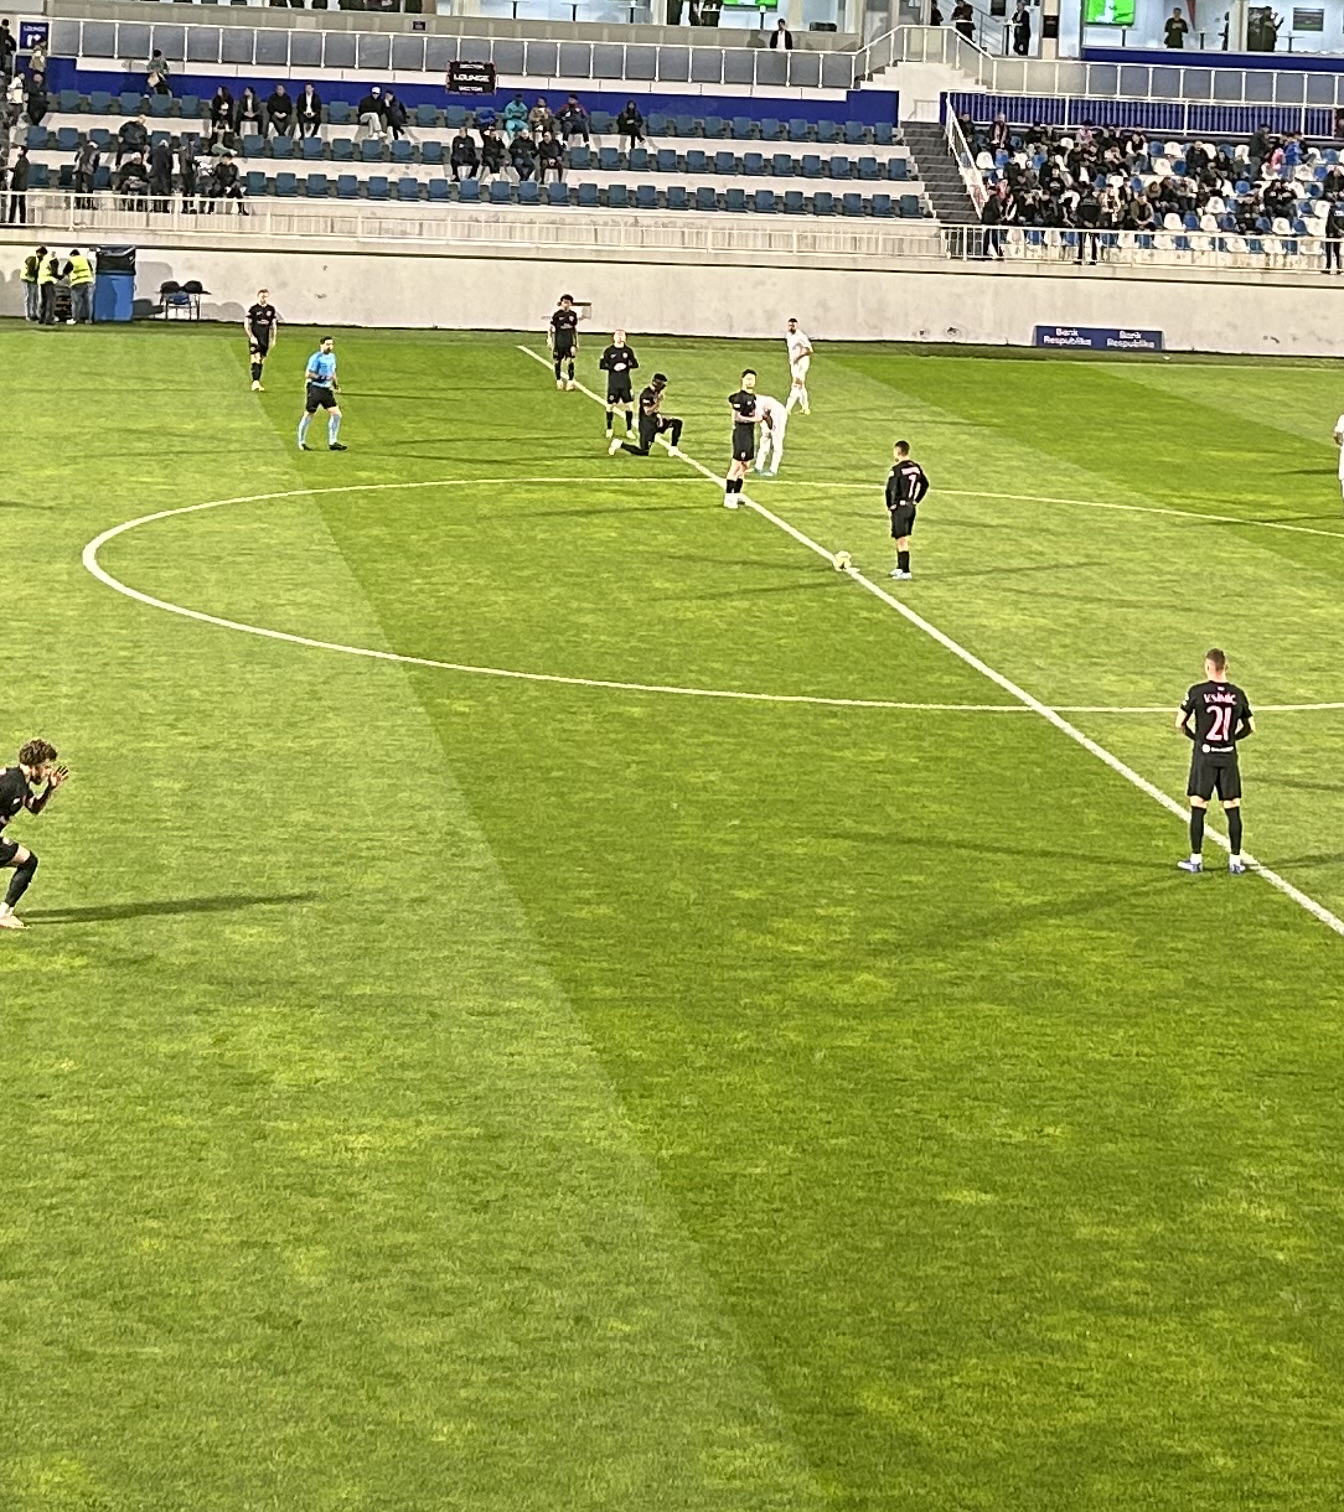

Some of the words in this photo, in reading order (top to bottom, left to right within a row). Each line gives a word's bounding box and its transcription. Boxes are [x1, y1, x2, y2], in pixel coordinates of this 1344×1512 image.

[1055, 327, 1079, 337] Bank
[1119, 330, 1142, 340] Bank
[1043, 335, 1092, 347] Respublika
[1206, 705, 1232, 741] 21
